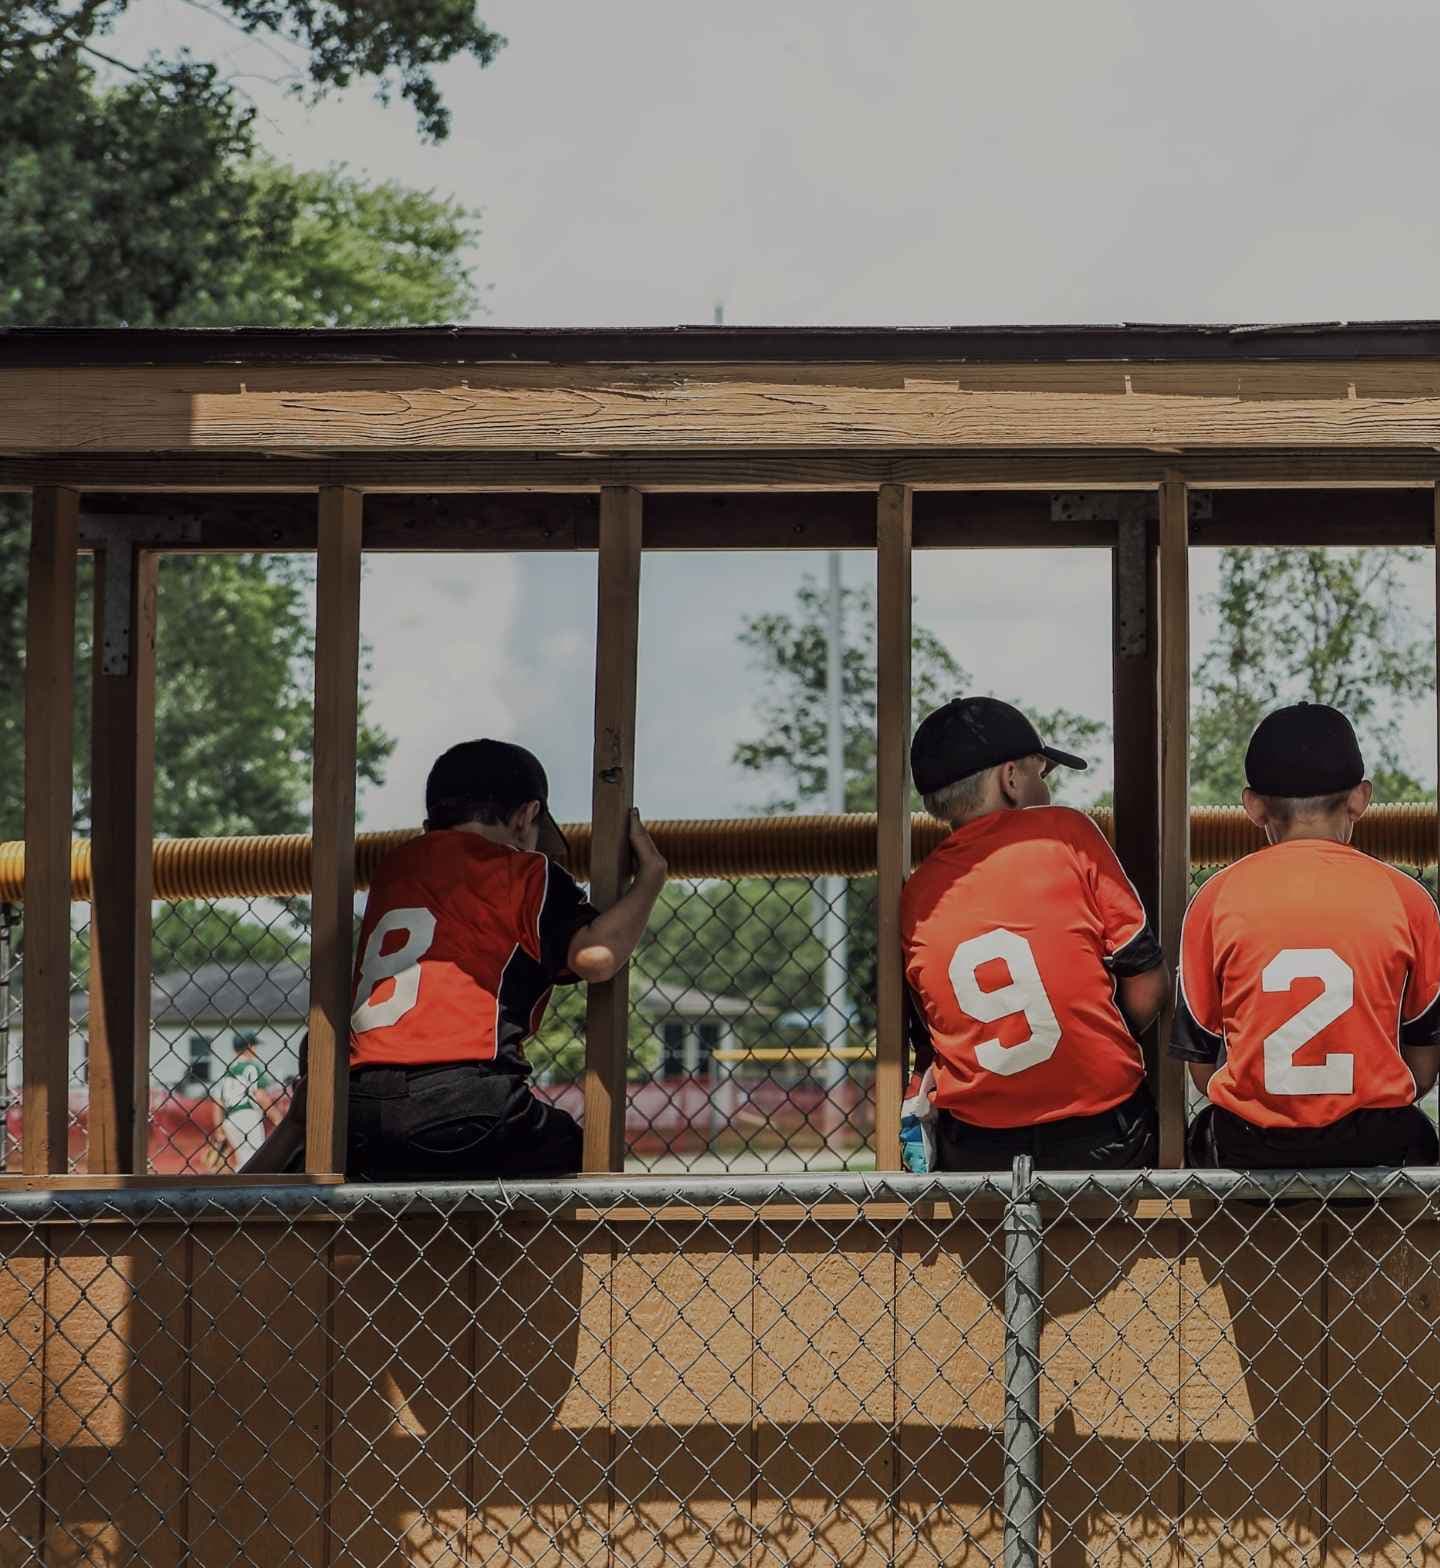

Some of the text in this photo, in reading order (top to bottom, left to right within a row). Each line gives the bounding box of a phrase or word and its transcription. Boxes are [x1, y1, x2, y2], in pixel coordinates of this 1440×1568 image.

[351, 907, 437, 1034] 8
[948, 927, 1062, 1077] 9
[1261, 948, 1355, 1096] 2
